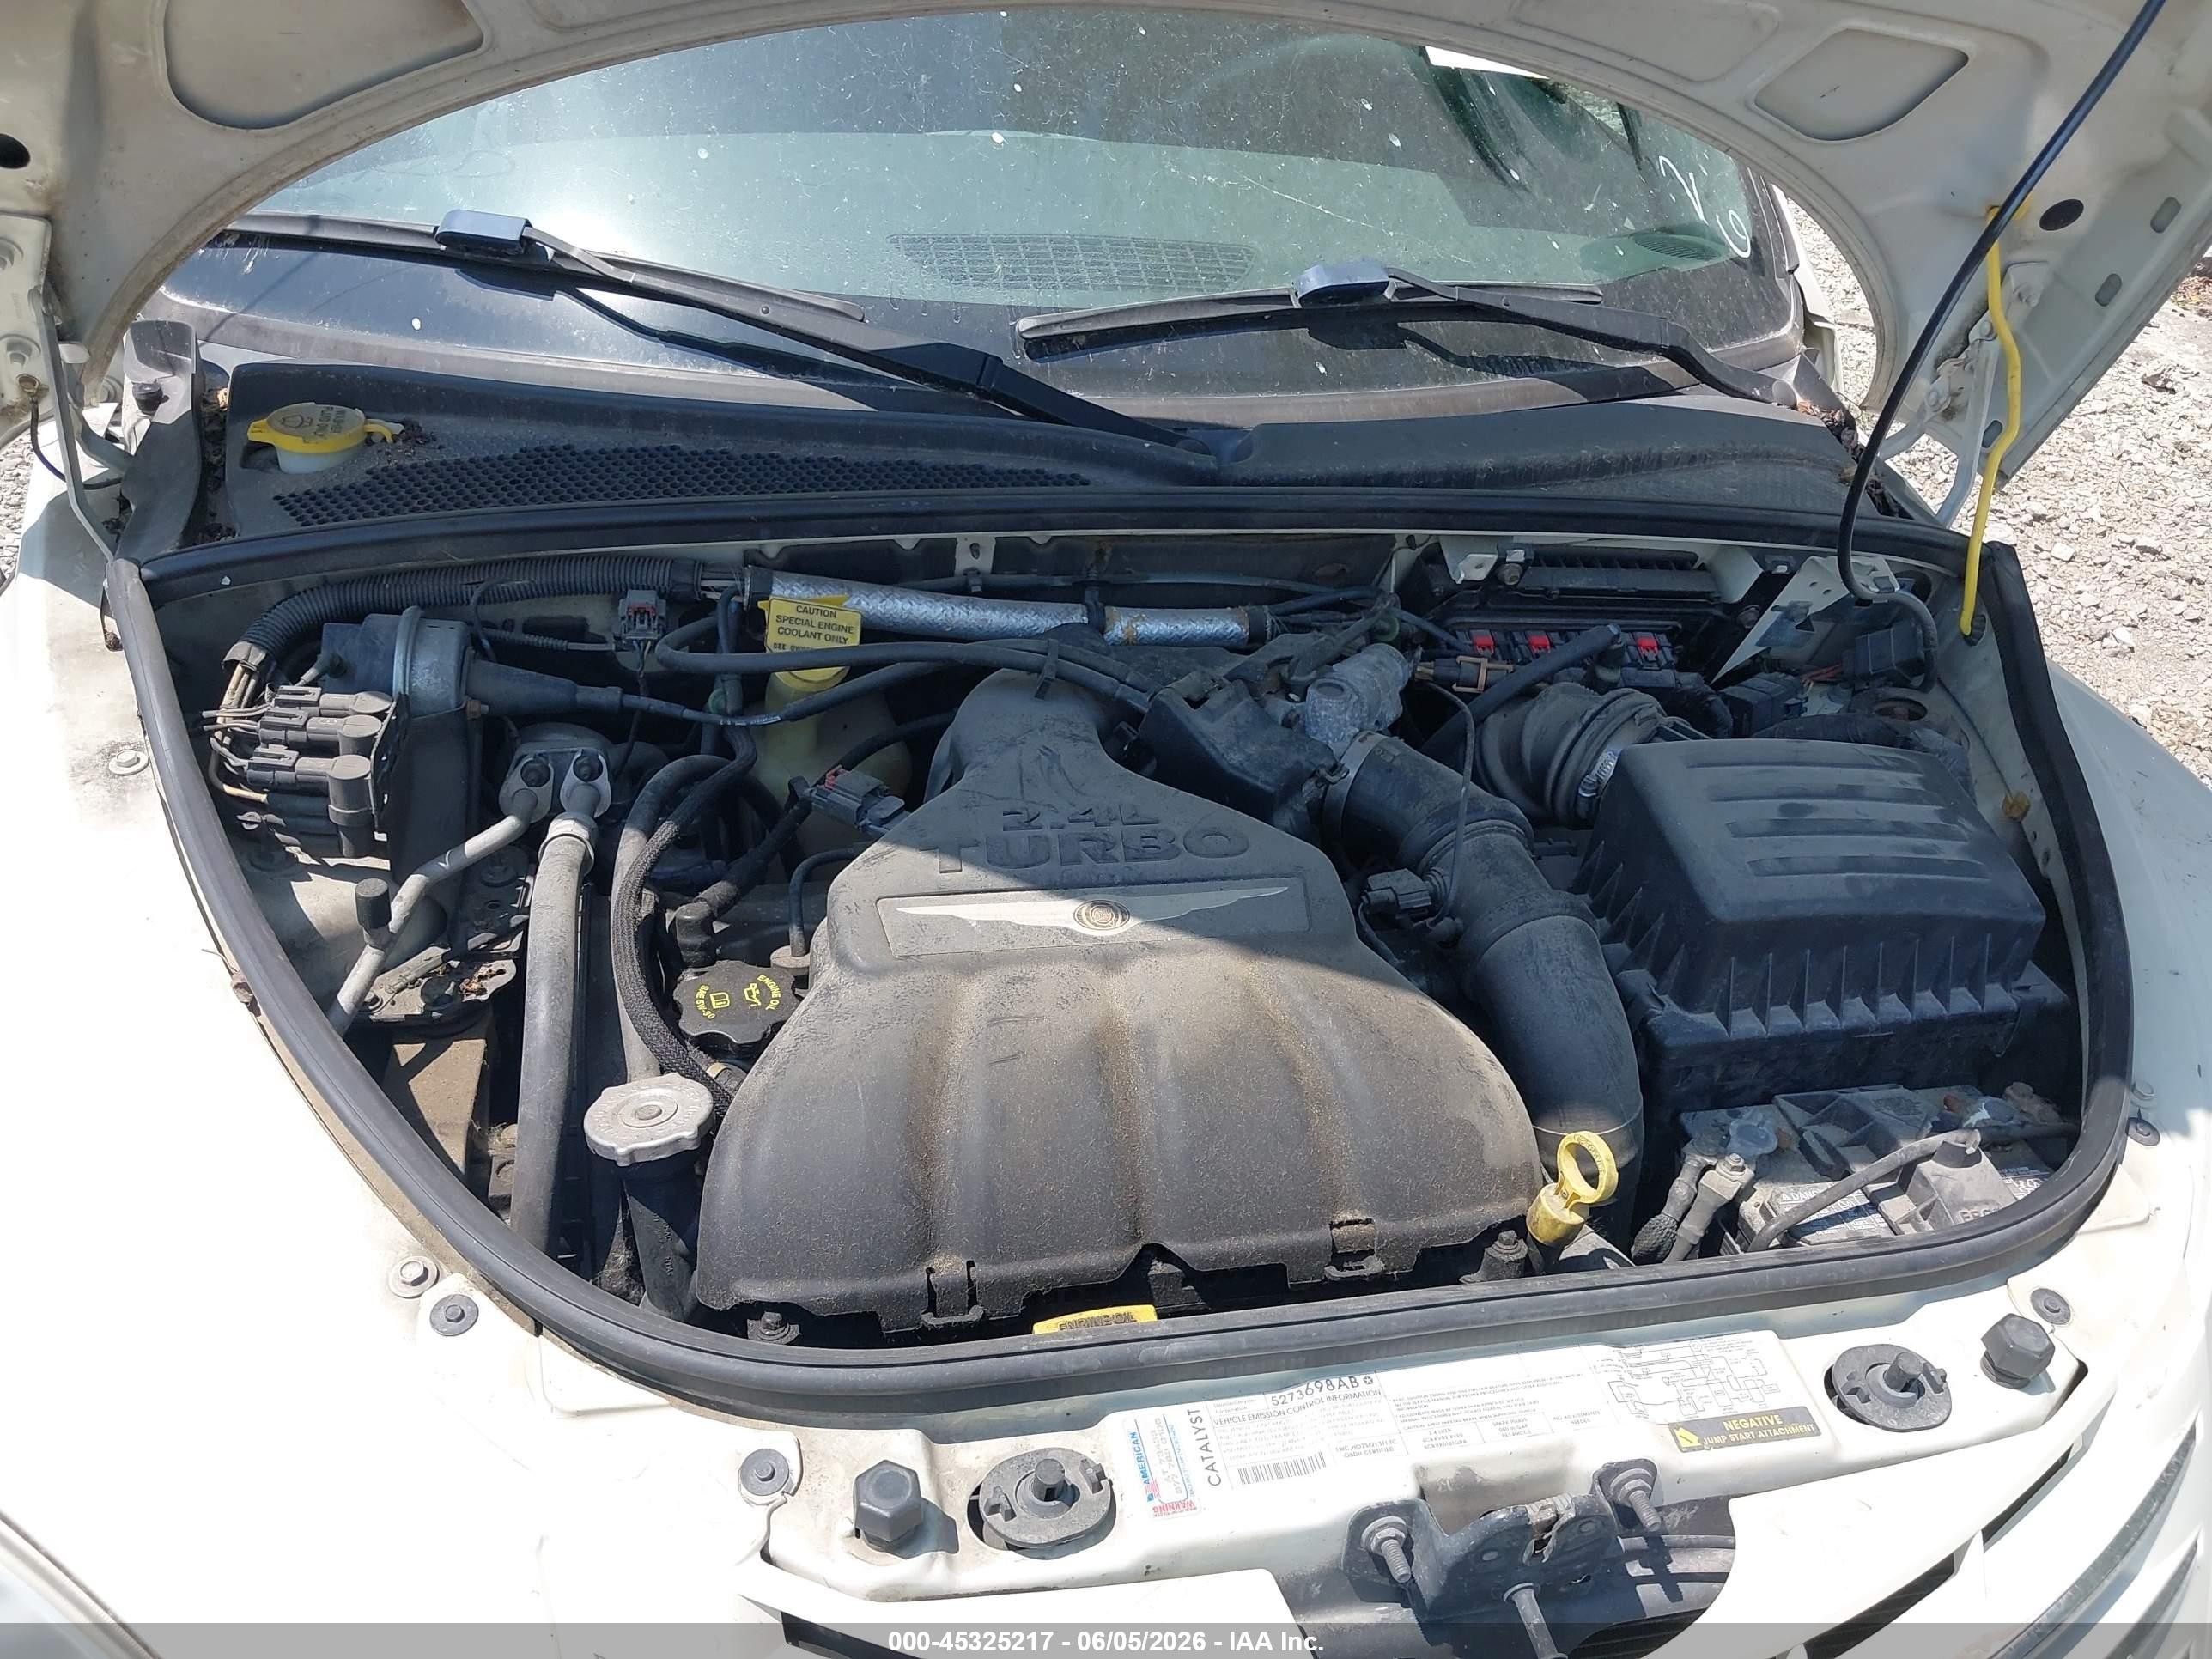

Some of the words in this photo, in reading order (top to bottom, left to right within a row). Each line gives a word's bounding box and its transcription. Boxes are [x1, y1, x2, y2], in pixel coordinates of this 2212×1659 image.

[796, 605, 836, 618] CAUTION
[775, 615, 816, 628] SPECIAL
[817, 621, 854, 634] ENGINE
[777, 627, 821, 641] COOLANT
[824, 634, 849, 644] ONLY
[1003, 804, 1160, 832] 2.4L
[920, 825, 1249, 874] TURBO
[696, 985, 709, 999] SAE
[757, 975, 781, 998] ENGINE
[696, 1000, 715, 1019] 5W-30
[765, 999, 780, 1011] OIL
[1058, 1312, 1112, 1331] ENGINE
[1113, 1310, 1138, 1325] OIL
[1271, 1376, 1359, 1406] 5273698AB
[1213, 1414, 1247, 1425] VEHICLE
[1247, 1408, 1285, 1421] EMISSION
[1286, 1397, 1324, 1415] CONTROL
[1326, 1389, 1382, 1402] INFORMATION
[1723, 1414, 1783, 1431] NEGATIVE
[1703, 1435, 1728, 1445] JUMP
[1729, 1431, 1755, 1442] START
[1758, 1424, 1815, 1439] ATTACHMENT
[1129, 1431, 1150, 1485] AMERICAN
[1187, 1409, 1222, 1486] CATALYST
[1152, 1499, 1196, 1513] WARNING
